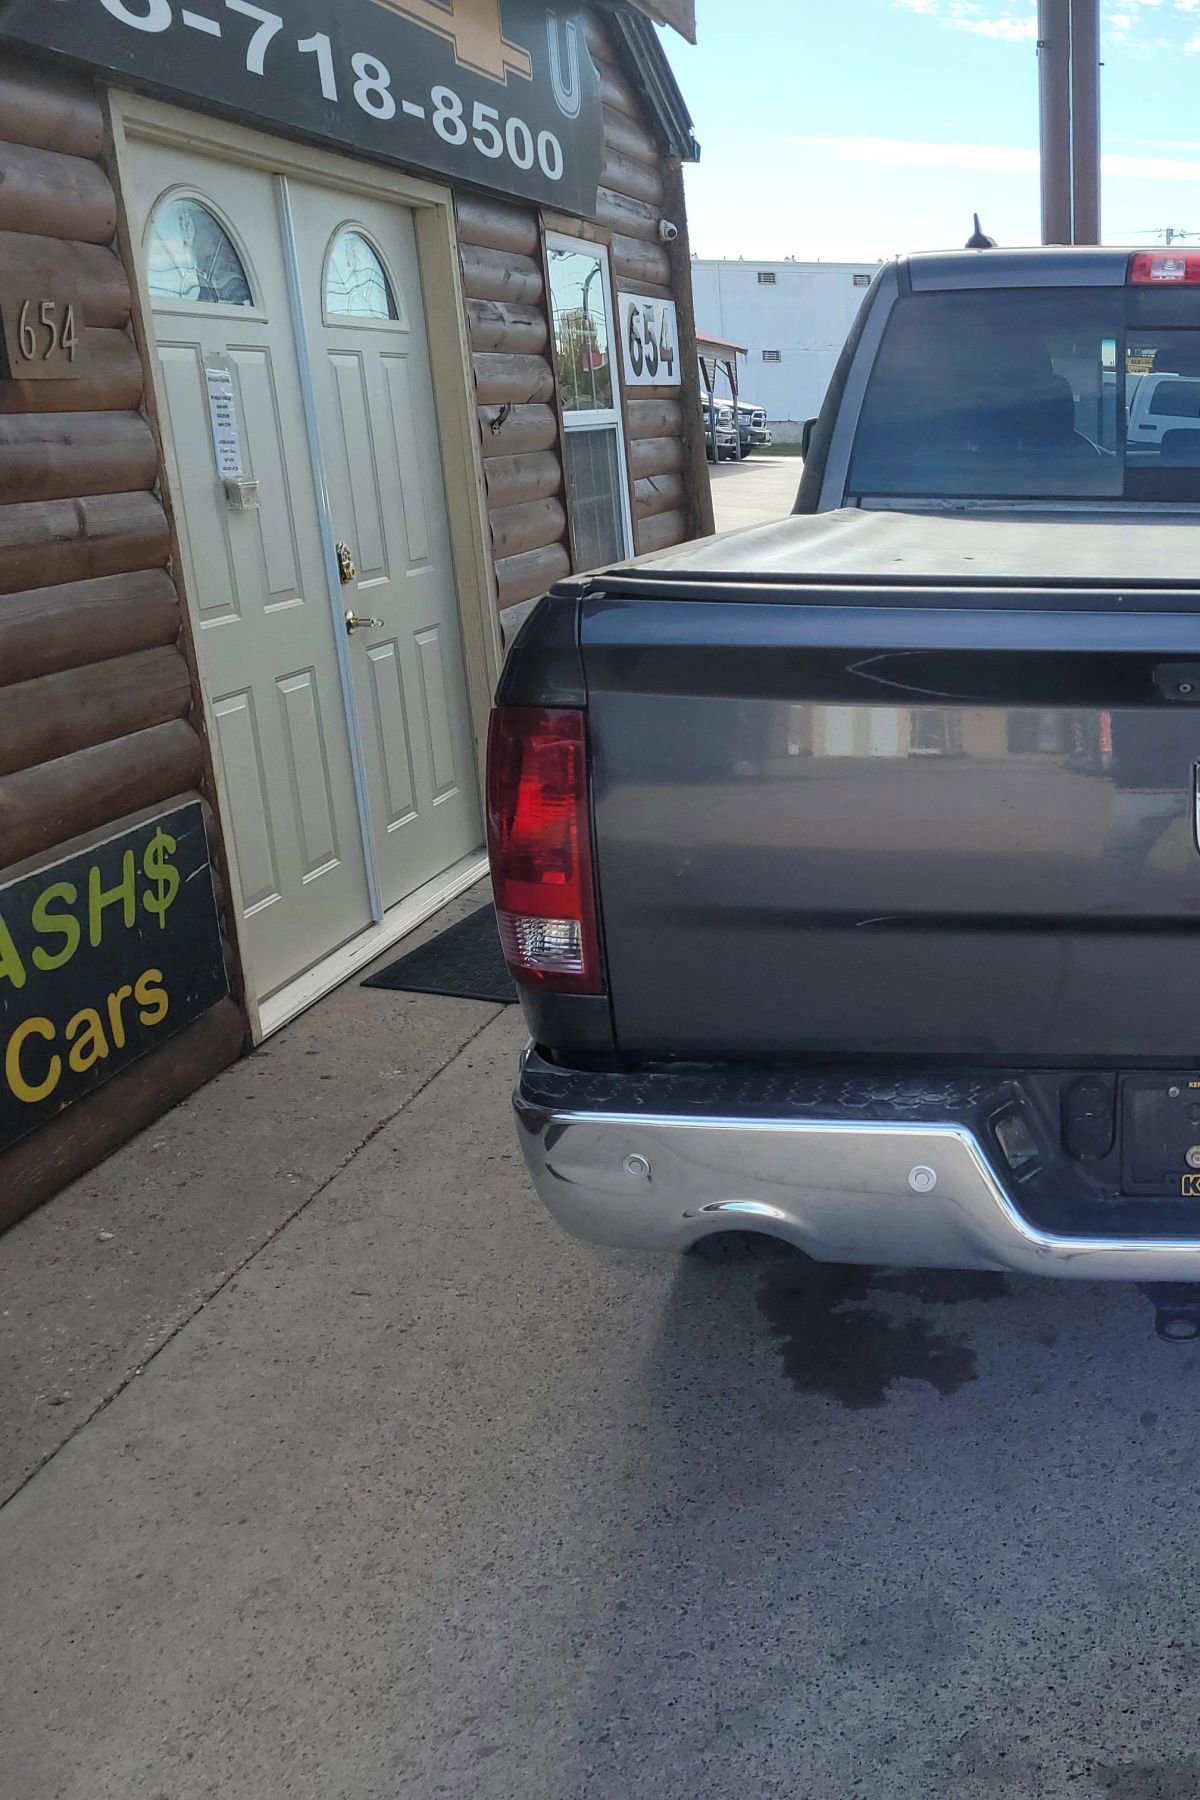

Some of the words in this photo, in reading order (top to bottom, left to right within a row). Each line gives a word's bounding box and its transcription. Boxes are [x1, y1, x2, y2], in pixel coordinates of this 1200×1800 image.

[546, 7, 582, 119] U
[19, 300, 79, 362] 654
[627, 302, 674, 378] 654
[5, 968, 169, 1103] Cars
